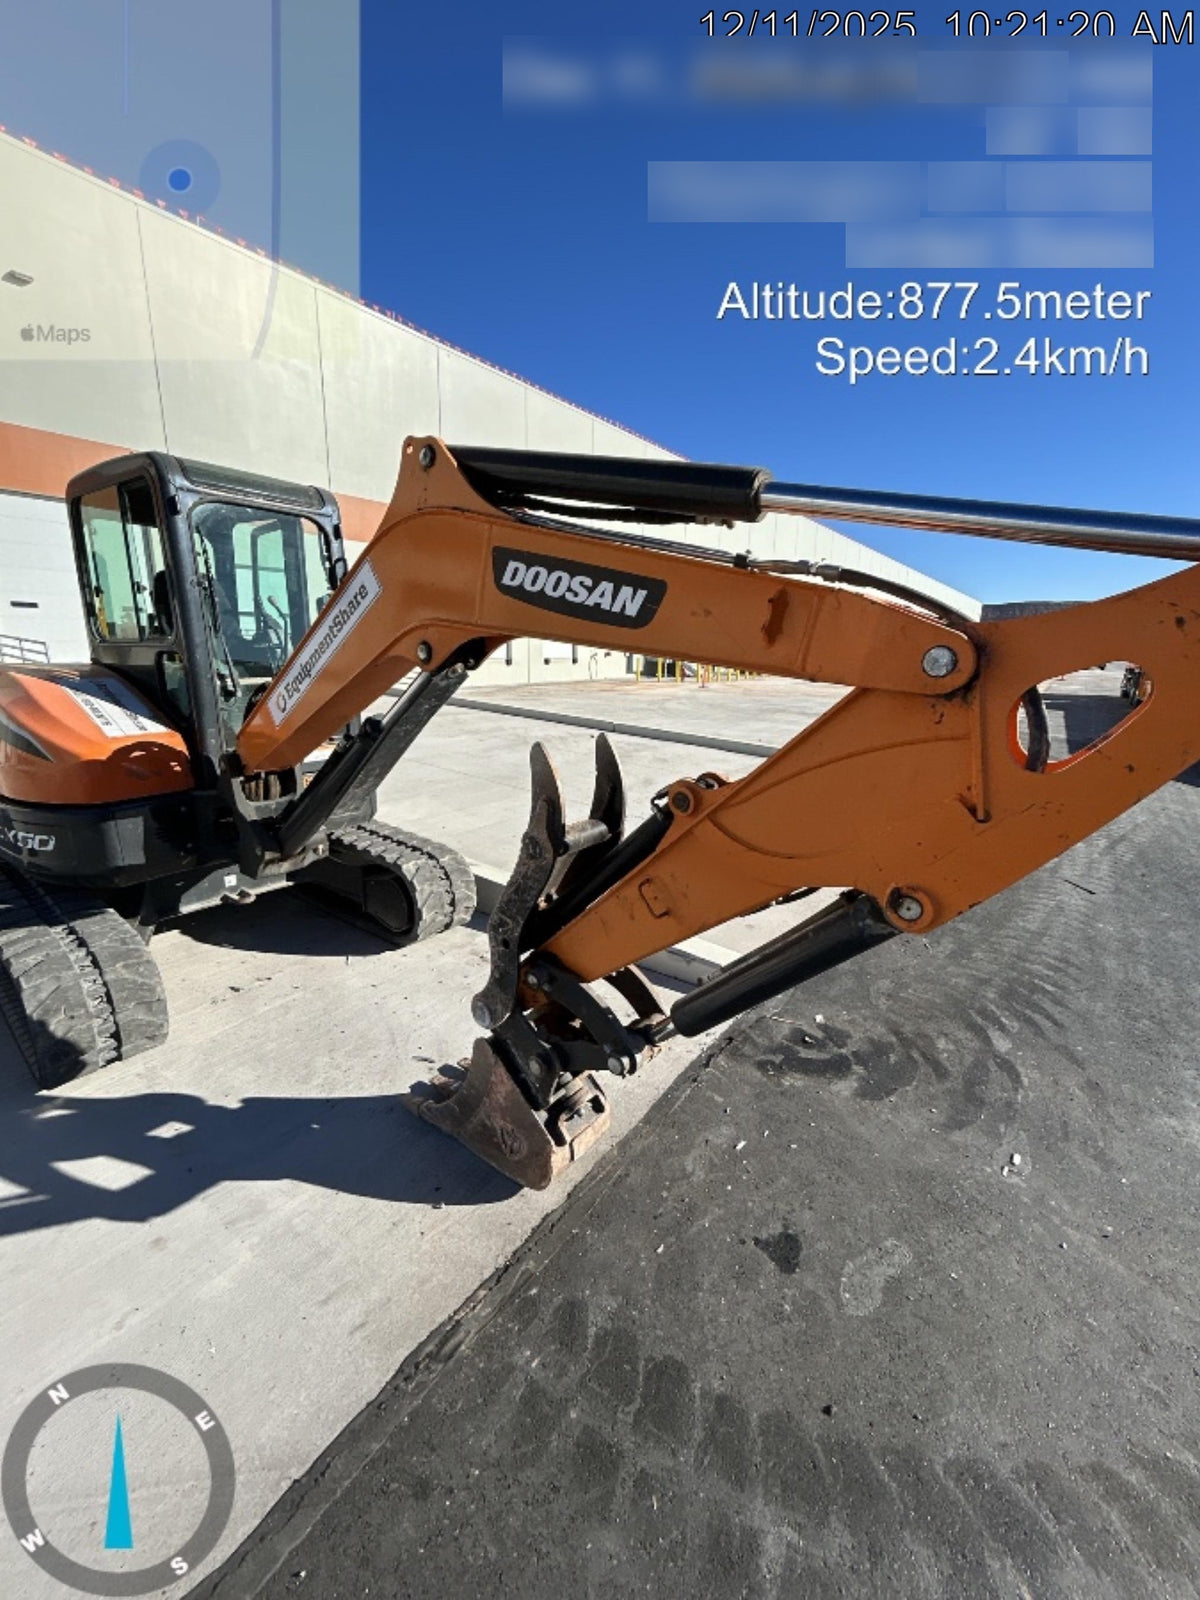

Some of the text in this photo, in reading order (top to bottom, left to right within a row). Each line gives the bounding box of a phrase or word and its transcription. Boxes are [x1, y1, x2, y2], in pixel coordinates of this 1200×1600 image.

[502, 560, 647, 617] DOOSAN
[284, 583, 369, 699] EquipmentShare
[0, 827, 56, 851] X50
